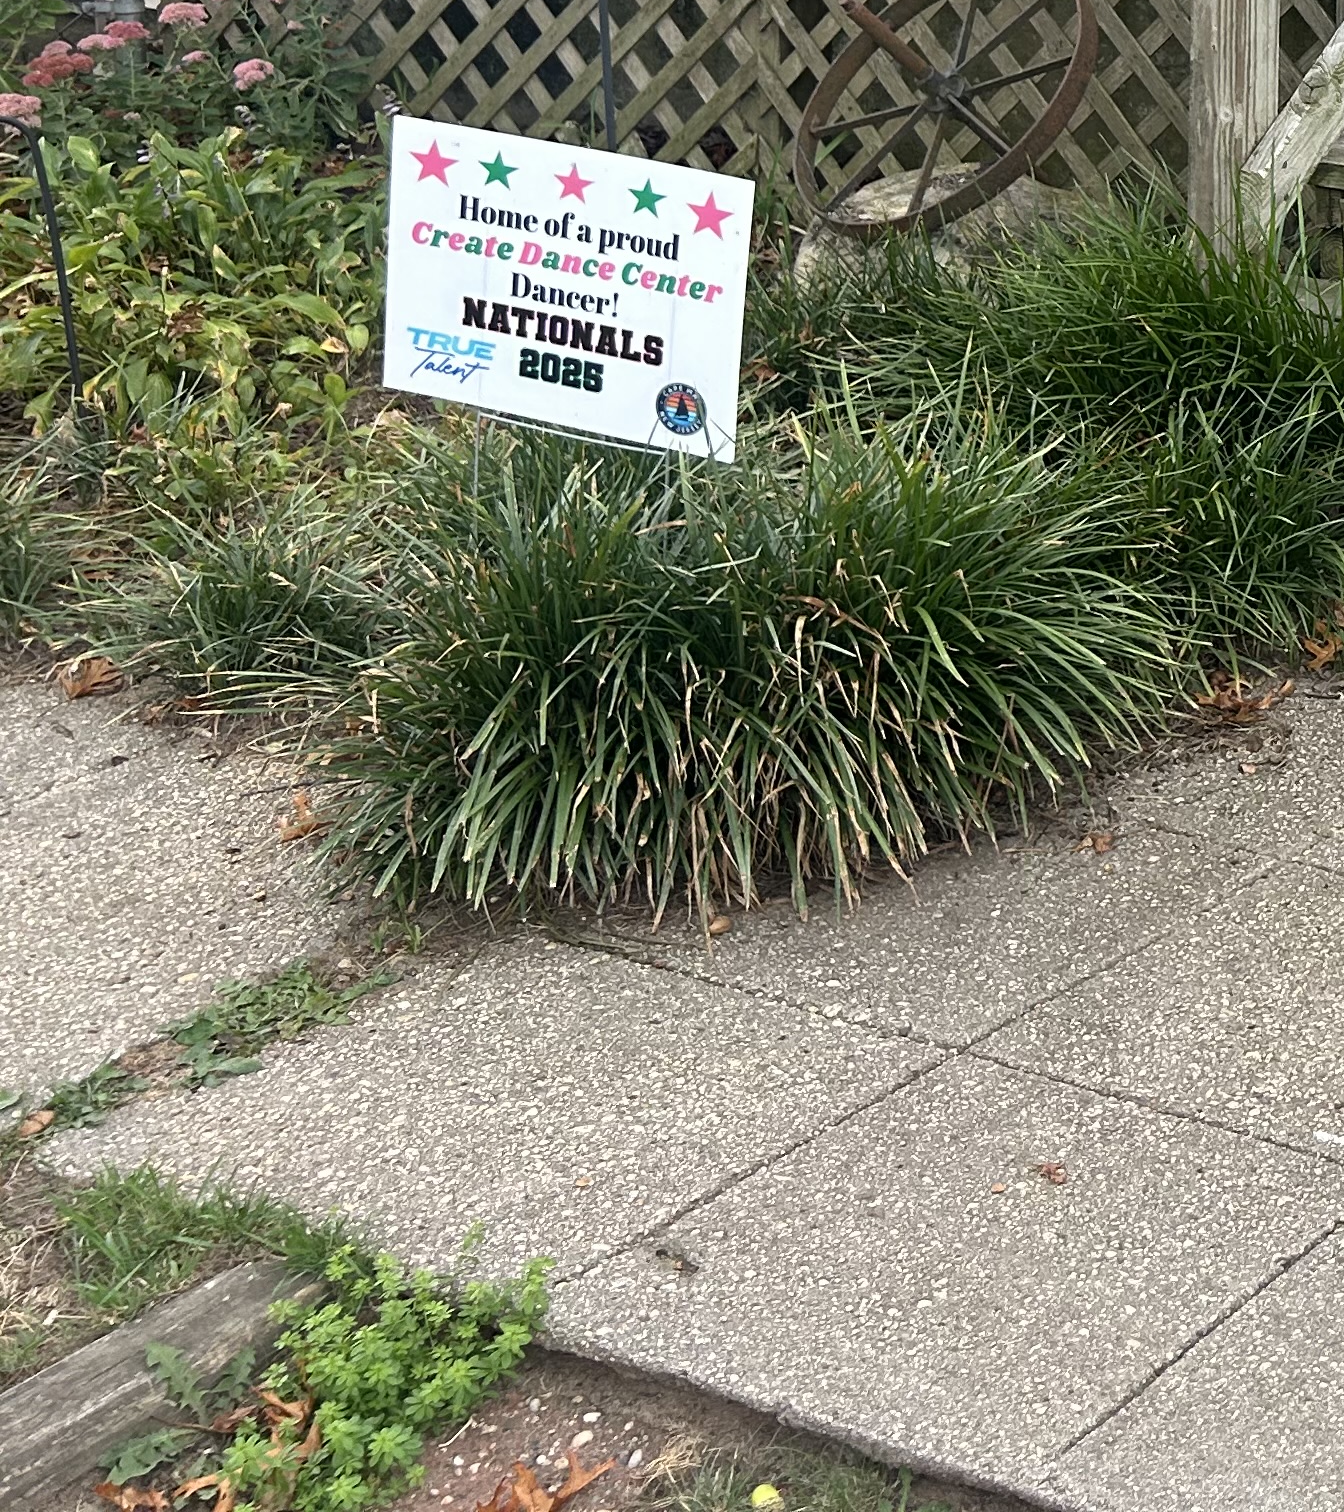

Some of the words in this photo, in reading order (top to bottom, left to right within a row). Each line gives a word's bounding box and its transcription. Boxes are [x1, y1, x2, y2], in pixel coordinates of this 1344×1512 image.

[459, 194, 538, 233] Home
[544, 212, 575, 238] of
[578, 223, 594, 243] a
[598, 228, 680, 261] proud
[411, 221, 514, 260] Create
[518, 241, 616, 280] Dance
[621, 262, 723, 304] Center
[510, 272, 619, 317] Dancer!
[407, 326, 496, 361] TRUE
[462, 296, 664, 367] NATIONALS
[410, 346, 490, 383] Talent
[518, 348, 605, 394] 2025
